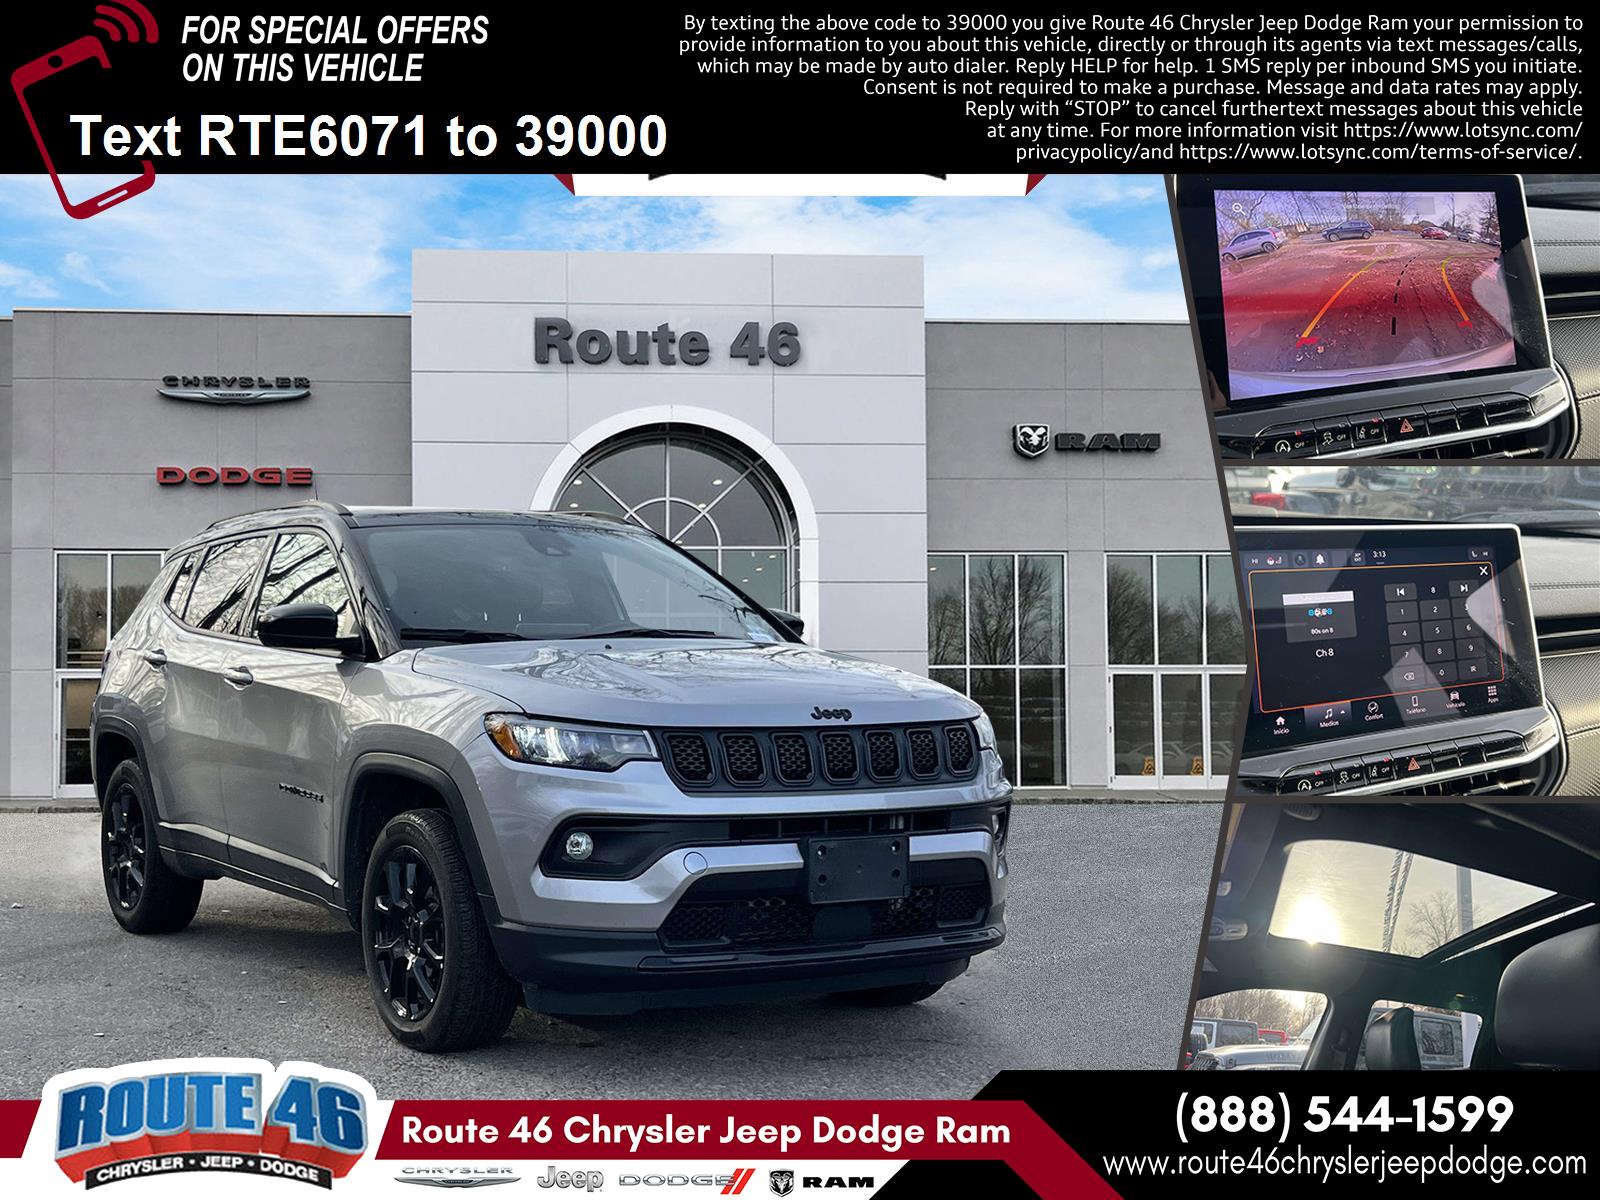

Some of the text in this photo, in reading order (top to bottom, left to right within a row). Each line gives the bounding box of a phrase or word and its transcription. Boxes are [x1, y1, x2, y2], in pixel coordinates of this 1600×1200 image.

[534, 317, 802, 367] Route 46
[162, 375, 311, 388] CHRYSLER
[1054, 432, 1162, 453] RAM
[156, 466, 313, 486] DODGE
[1372, 550, 1387, 559] 3:13
[1430, 586, 1436, 594] 8
[1315, 648, 1334, 658] Ch 8
[810, 706, 852, 722] Jeep
[1364, 713, 1384, 721] Confort
[1320, 720, 1340, 728] Medios
